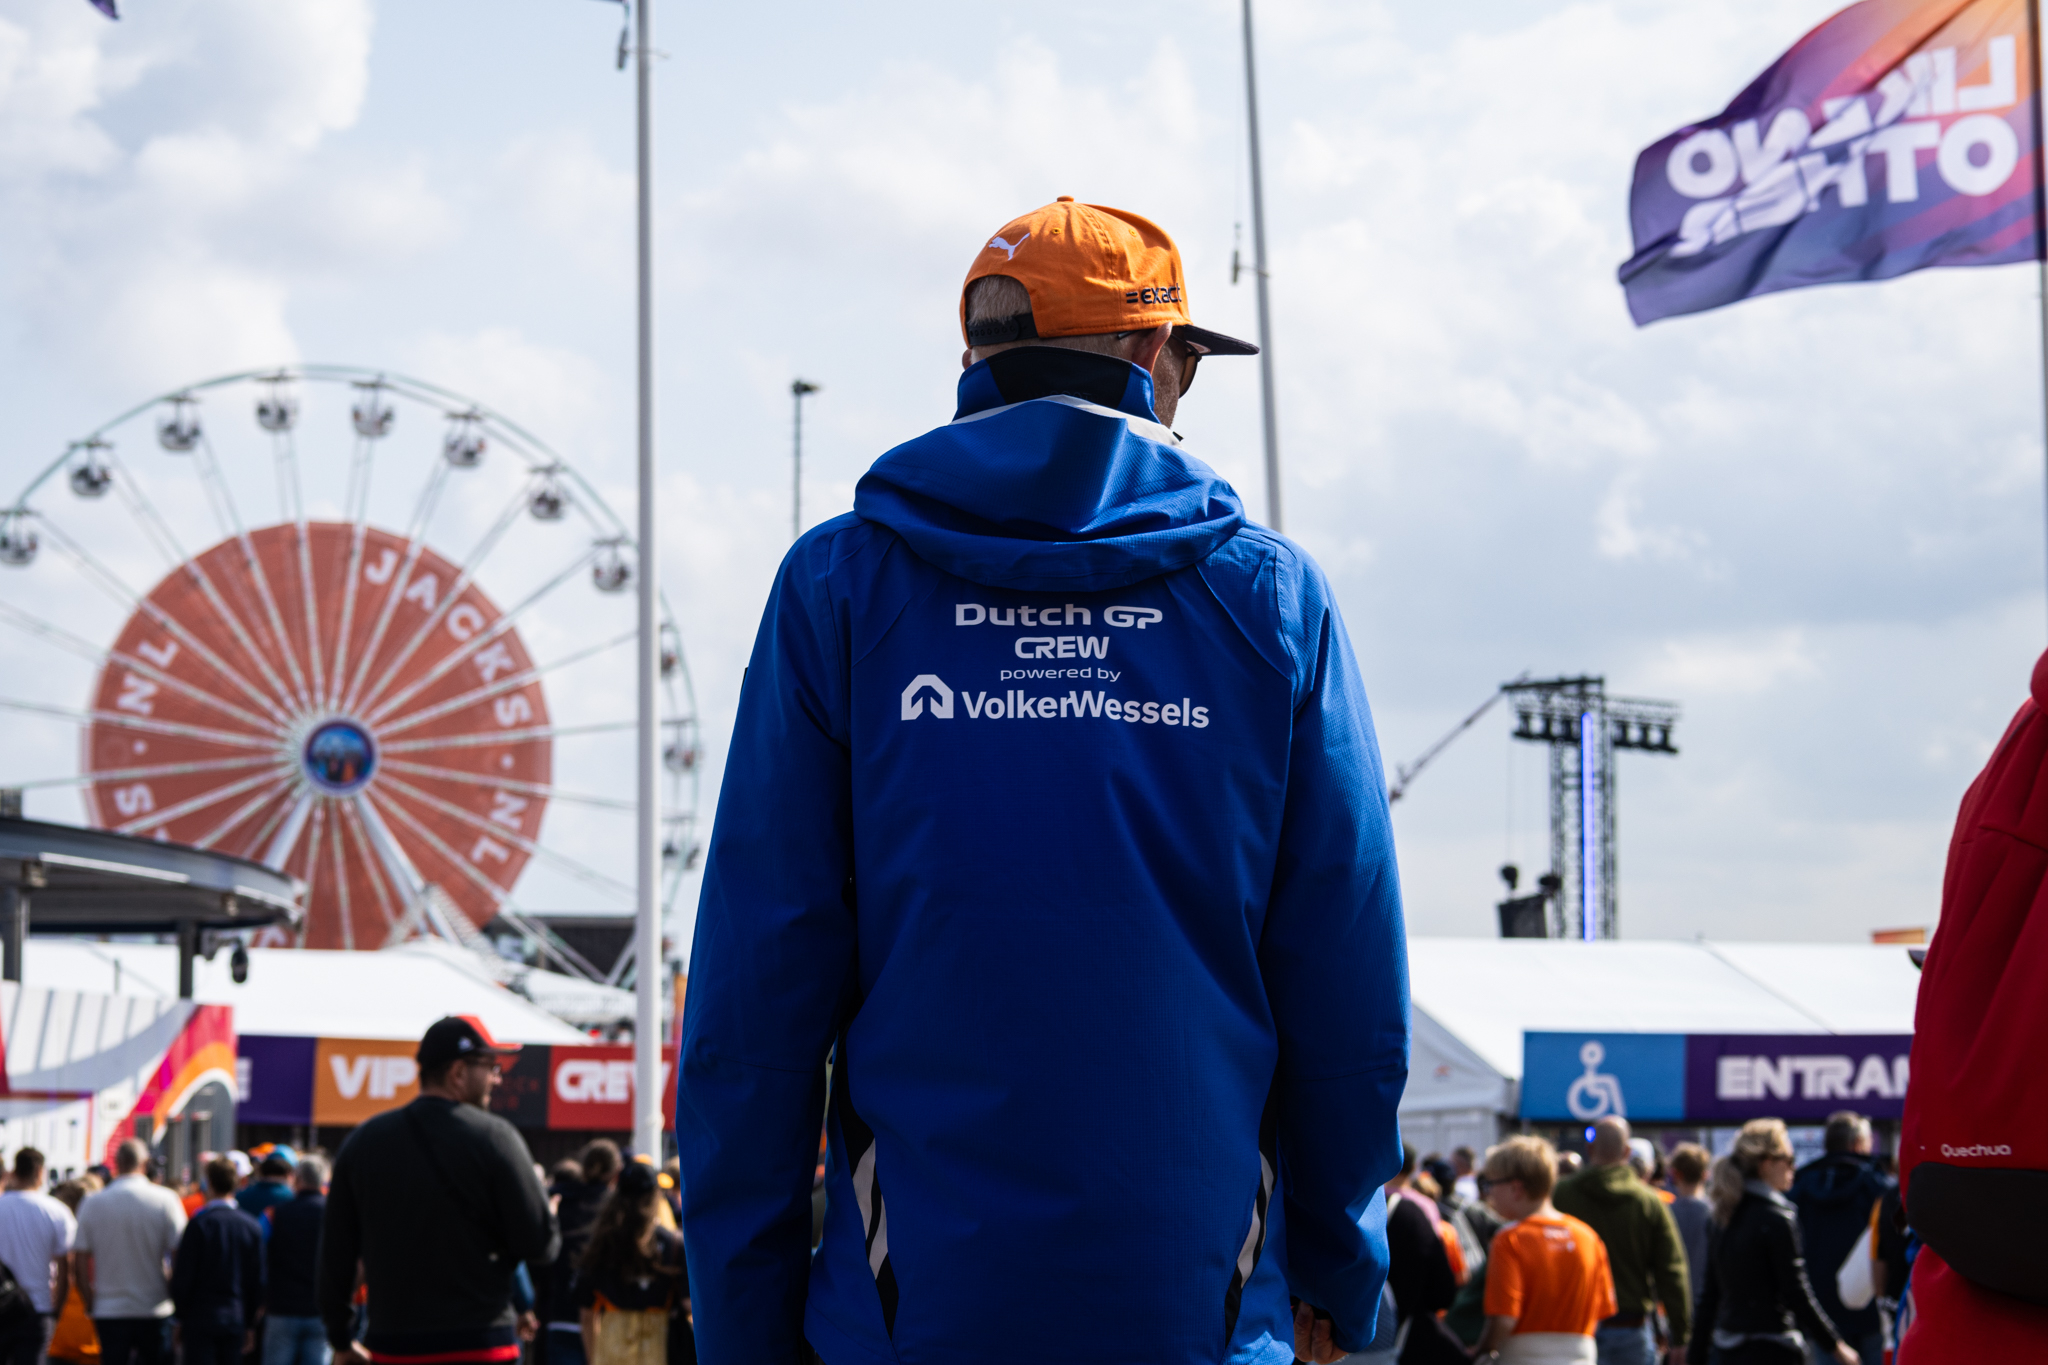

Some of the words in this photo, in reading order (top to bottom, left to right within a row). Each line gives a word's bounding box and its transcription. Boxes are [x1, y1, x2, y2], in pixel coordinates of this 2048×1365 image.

[955, 603, 1092, 628] Dutch
[1103, 605, 1163, 630] GP
[1014, 635, 1110, 660] CREW
[1000, 666, 1092, 683] powered
[1097, 667, 1122, 683] by
[961, 689, 1210, 729] VolkerWessels
[331, 1054, 419, 1100] VIP
[1940, 1143, 2012, 1158] Quechua
